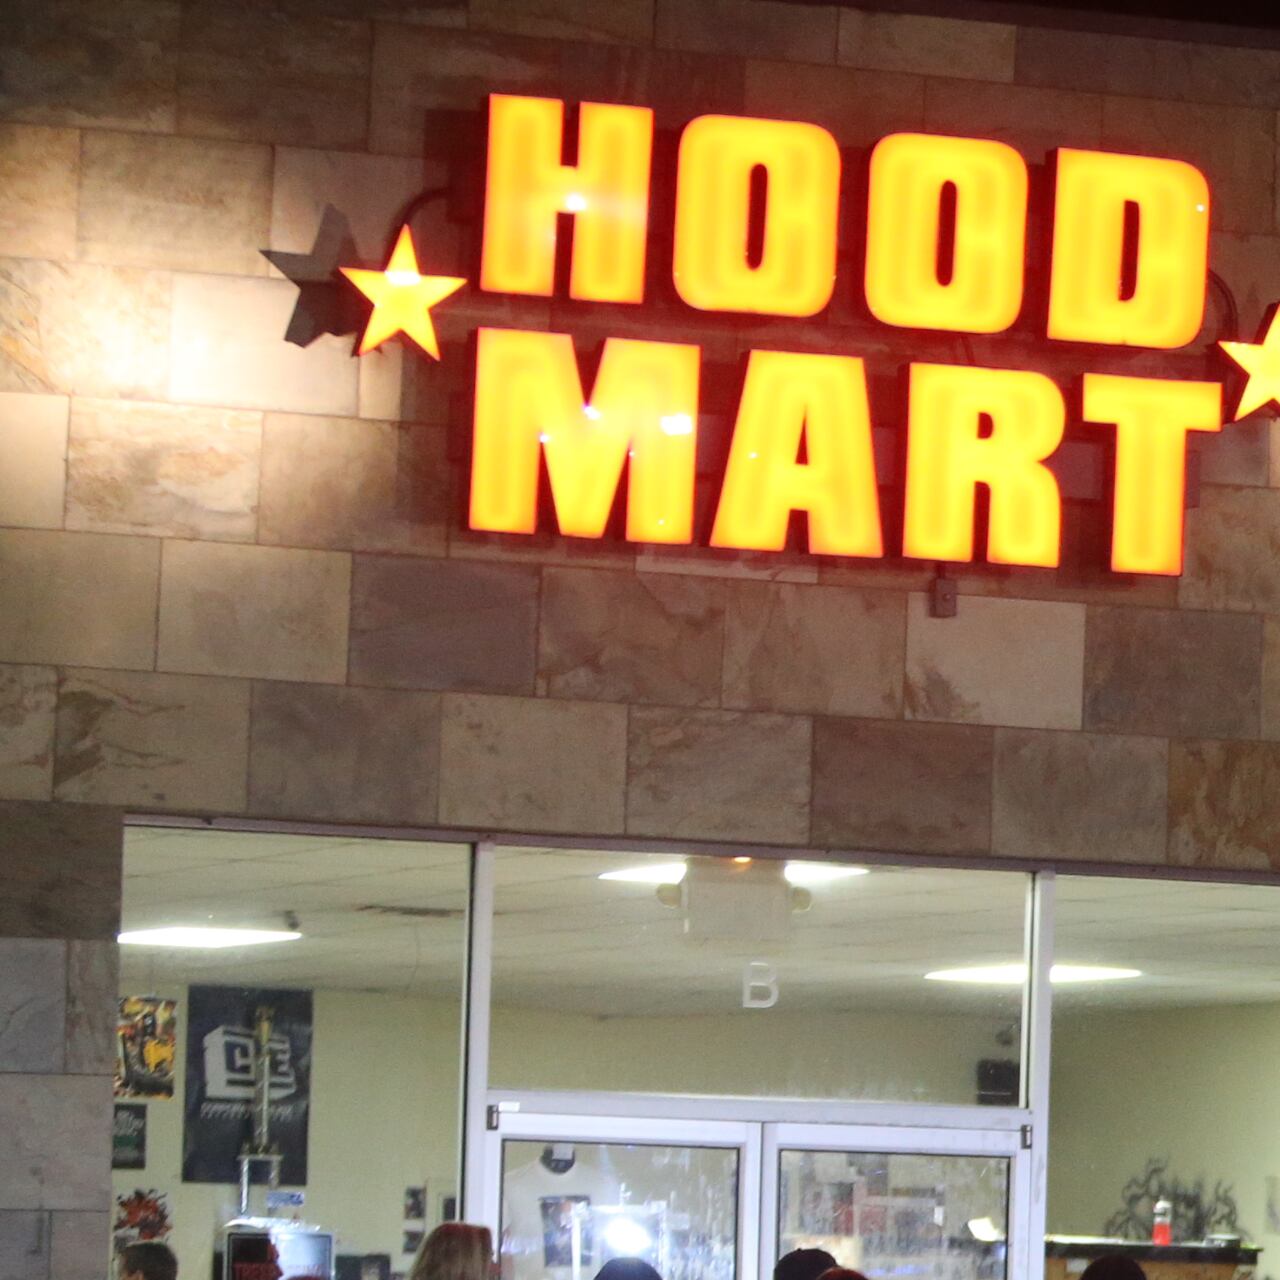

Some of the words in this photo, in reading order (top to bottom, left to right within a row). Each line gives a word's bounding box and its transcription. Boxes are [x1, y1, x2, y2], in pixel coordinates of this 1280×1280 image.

[479, 92, 1211, 350] HOOD
[468, 327, 1223, 577] MART
[742, 962, 779, 1008] B
